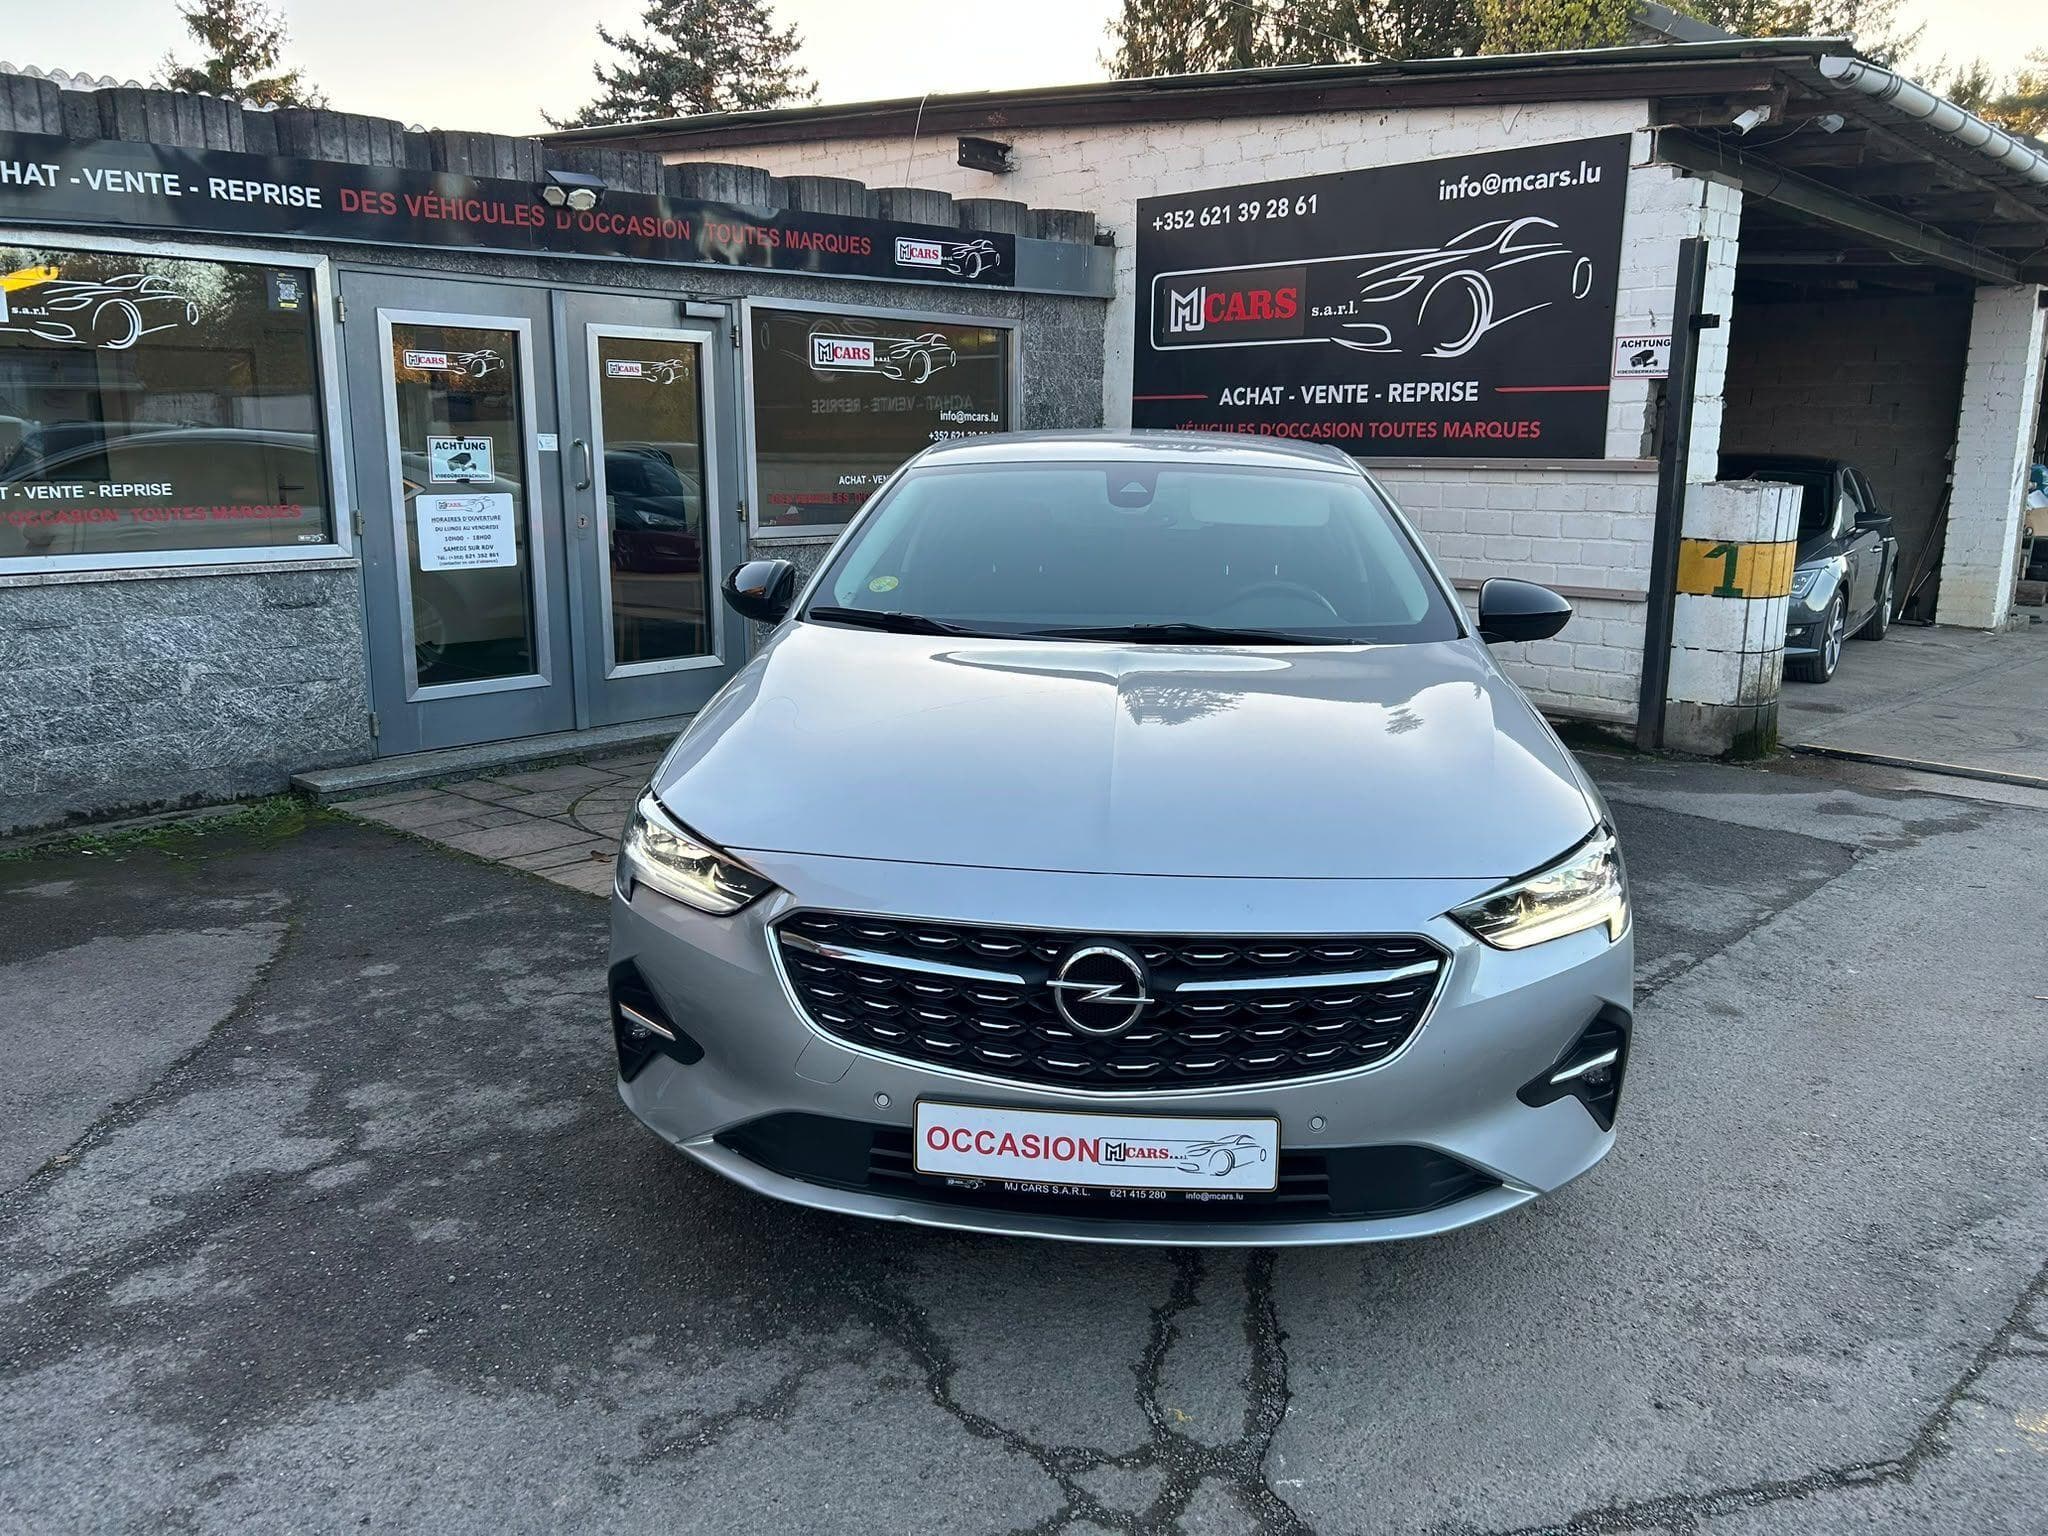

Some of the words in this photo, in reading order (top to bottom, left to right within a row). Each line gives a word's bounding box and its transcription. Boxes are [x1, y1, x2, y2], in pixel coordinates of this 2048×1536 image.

[1438, 161, 1601, 201] info@mcars.lu
[207, 177, 322, 209] REPRISE
[340, 188, 398, 216] DES
[403, 190, 546, 228] VÉHICULES
[556, 209, 691, 241] D'OCCASION
[706, 223, 780, 248] TOUTES
[785, 230, 872, 256] MARQUES
[1152, 209, 1195, 231] +352
[1200, 205, 1230, 226] 621
[1238, 201, 1261, 222] 39
[1266, 198, 1289, 218] 28
[1295, 194, 1317, 216] 61
[11, 306, 49, 315] s.a.r.l.
[1311, 301, 1359, 317] s.a.r.l.
[1621, 339, 1670, 348] ACHTUNG
[1219, 387, 1284, 406] ACHAT
[1301, 384, 1369, 404] VENTE
[1388, 381, 1479, 402] REPRISE
[940, 410, 998, 424] info@mcars.lu
[929, 431, 948, 441] +352
[1260, 422, 1364, 439] D'OCCASION
[1368, 422, 1438, 438] TOUTES
[1443, 421, 1541, 439] MARQUES
[435, 441, 486, 450] ACHTUNG
[839, 475, 866, 485] ACHAT
[872, 474, 892, 484] VEN
[24, 485, 84, 499] VENTE
[99, 483, 173, 498] REPRISE
[0, 506, 119, 527] 'OCCASION
[130, 506, 207, 523] TOUTES
[1703, 543, 1743, 598] 1
[926, 1126, 1098, 1163] OCCASION
[1004, 1182, 1018, 1191] MJ
[1020, 1183, 1049, 1194] CARS
[1052, 1185, 1091, 1196] S.A.R.L.
[1110, 1189, 1127, 1198] 621
[1129, 1189, 1146, 1199] 415
[1148, 1190, 1167, 1200] 280
[1185, 1192, 1244, 1201] info@mcars.lu
